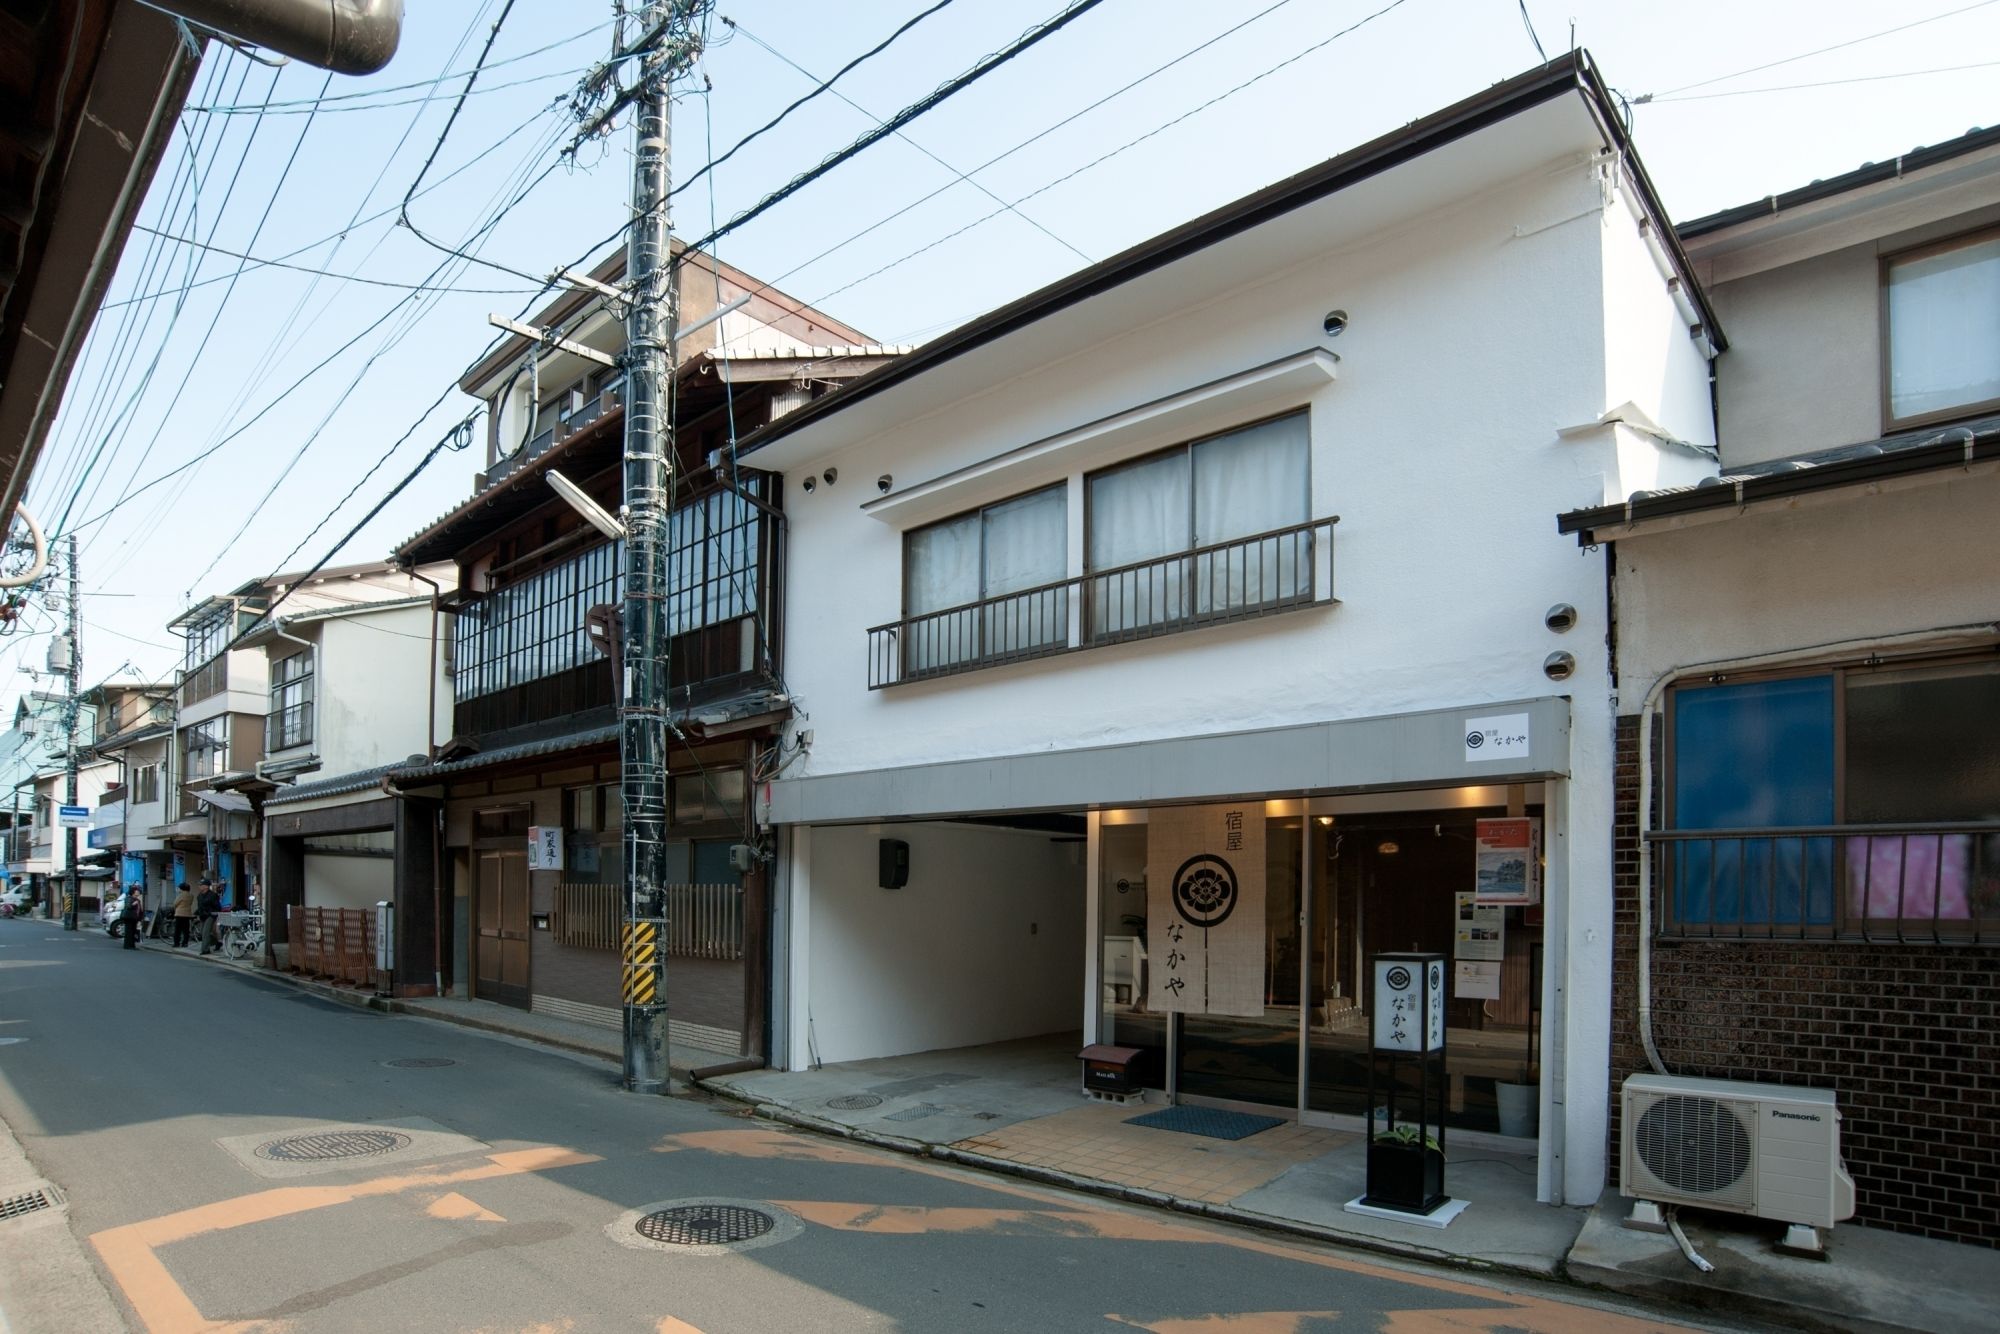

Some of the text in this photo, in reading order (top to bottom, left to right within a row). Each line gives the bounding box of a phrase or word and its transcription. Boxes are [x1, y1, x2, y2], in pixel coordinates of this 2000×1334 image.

[1494, 735, 1526, 746] なかや
[1225, 810, 1243, 851] 宿屋
[1164, 920, 1186, 998] なかや
[1390, 995, 1407, 1044] なかや
[1772, 1110, 1821, 1122] Panasonic
